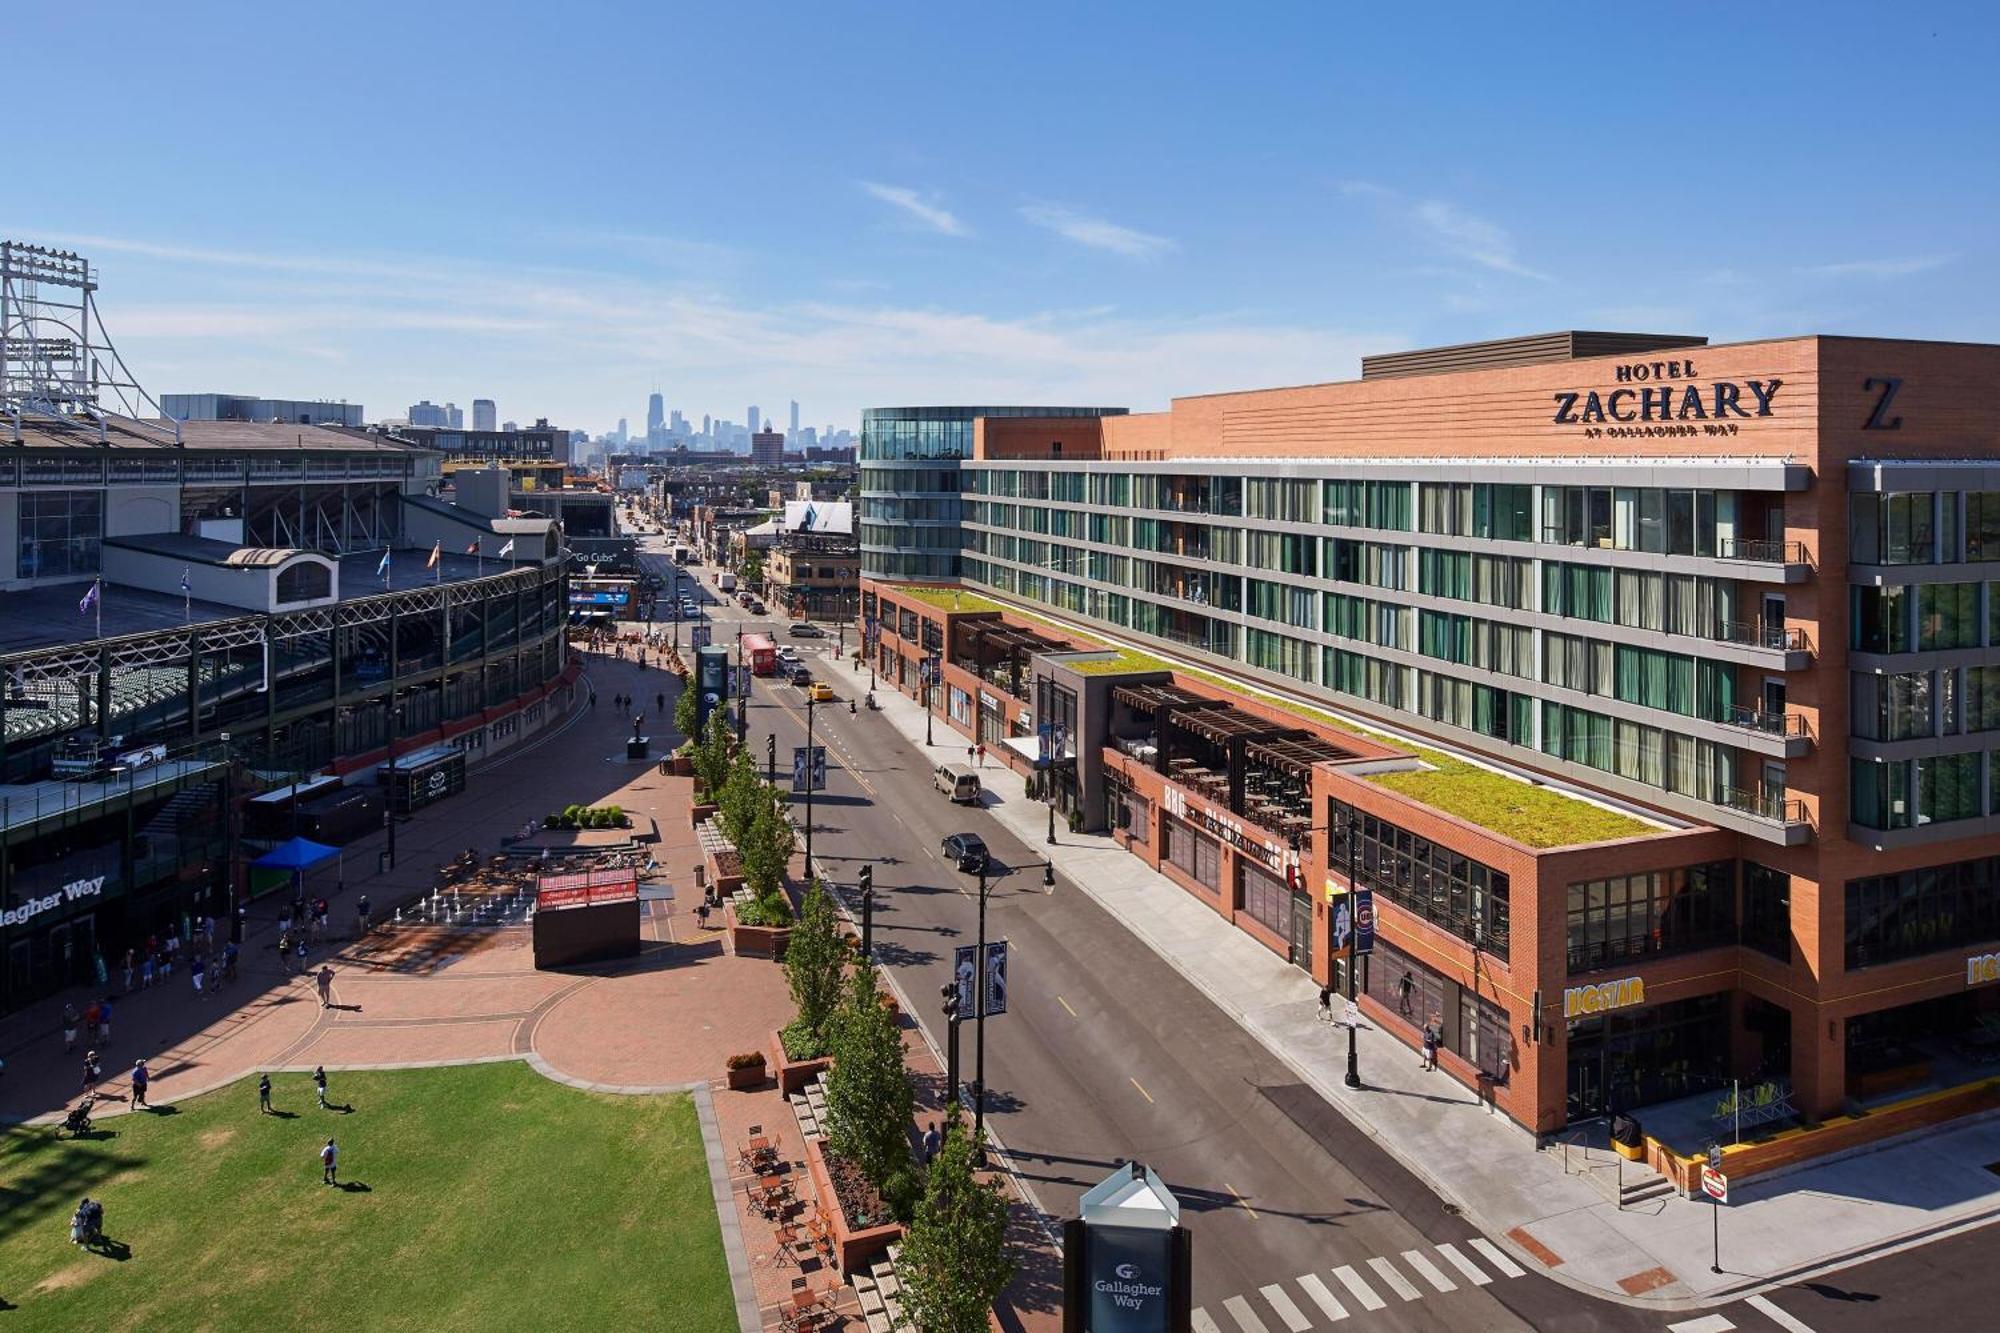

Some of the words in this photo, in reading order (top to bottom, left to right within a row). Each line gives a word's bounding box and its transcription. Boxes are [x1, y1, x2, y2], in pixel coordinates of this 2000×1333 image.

[1615, 360, 1698, 382] HOTEL
[1553, 378, 1783, 424] ZACHARY
[1862, 376, 1904, 430] Z
[62, 876, 105, 900] Way
[1095, 1280, 1162, 1296] Gallagher
[1114, 1294, 1143, 1310] Way
